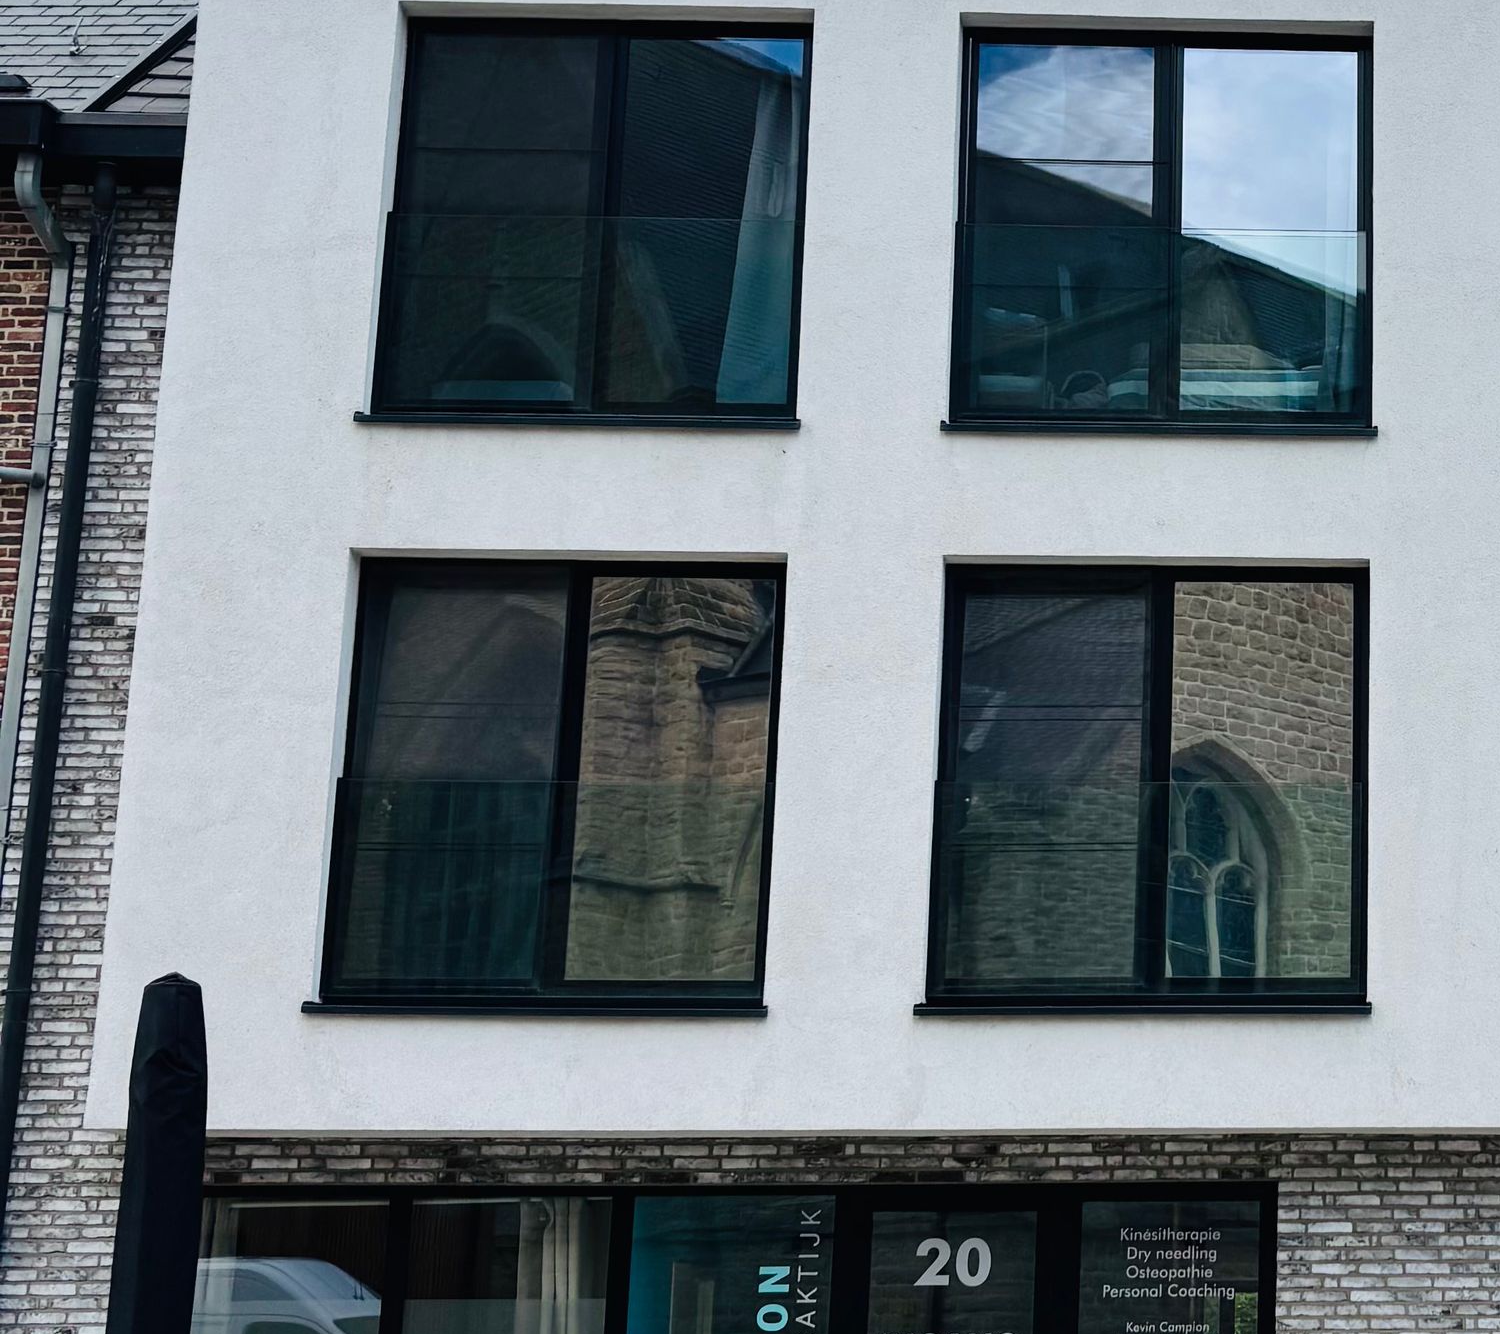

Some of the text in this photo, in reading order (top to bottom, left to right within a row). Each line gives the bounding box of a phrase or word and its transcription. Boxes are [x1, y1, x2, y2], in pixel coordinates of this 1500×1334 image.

[1120, 1227, 1221, 1244] Kinésitherapie
[913, 1237, 992, 1287] 20
[1127, 1245, 1217, 1262] Dry needling
[1126, 1265, 1213, 1281] Osteopathie
[1102, 1283, 1235, 1300] Personal Coaching
[1126, 1321, 1210, 1334] Kevin Campion
